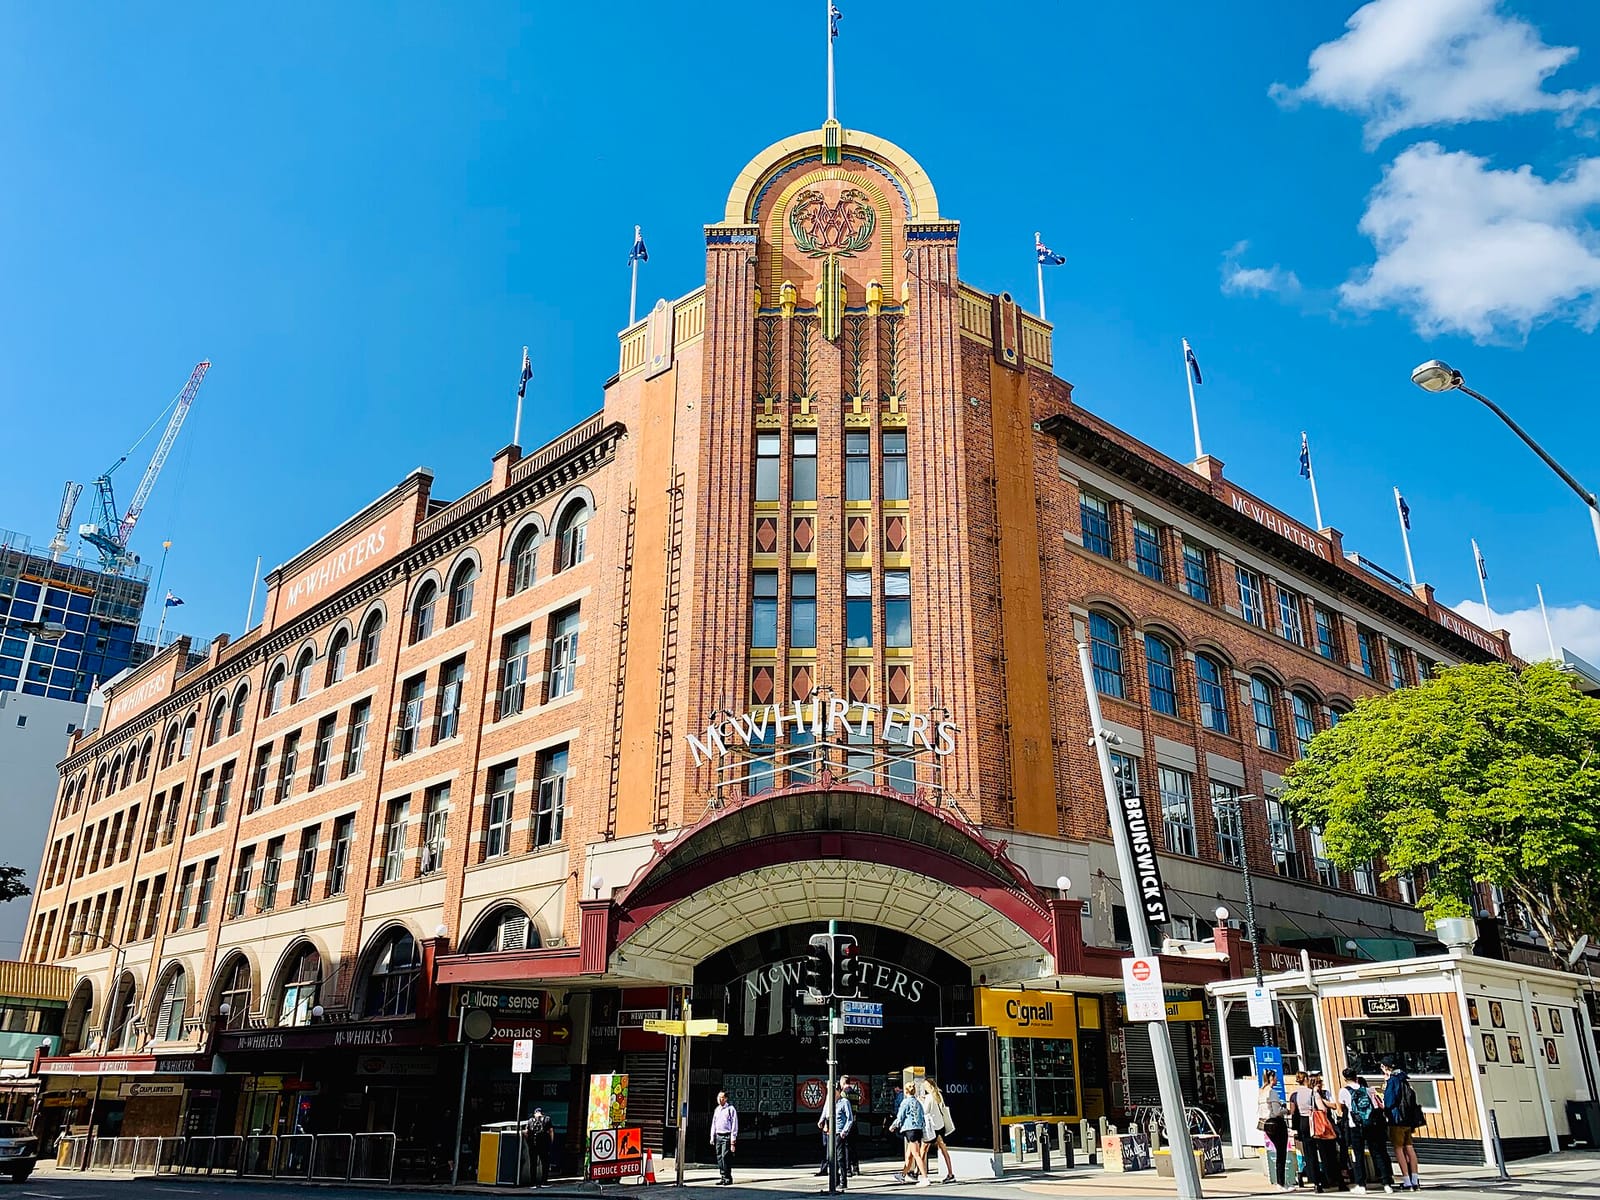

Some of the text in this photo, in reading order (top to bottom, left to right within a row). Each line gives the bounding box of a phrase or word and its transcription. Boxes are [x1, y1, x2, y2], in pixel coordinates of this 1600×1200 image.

[1124, 797, 1166, 922] BRUNSWICK ST
[744, 957, 925, 1003] McWTERS
[508, 995, 540, 1009] sense
[1006, 999, 1053, 1027] Cignall
[946, 1083, 969, 1094] LOOK
[595, 1138, 612, 1153] 40
[593, 1163, 640, 1176] REDUCE SPEED
